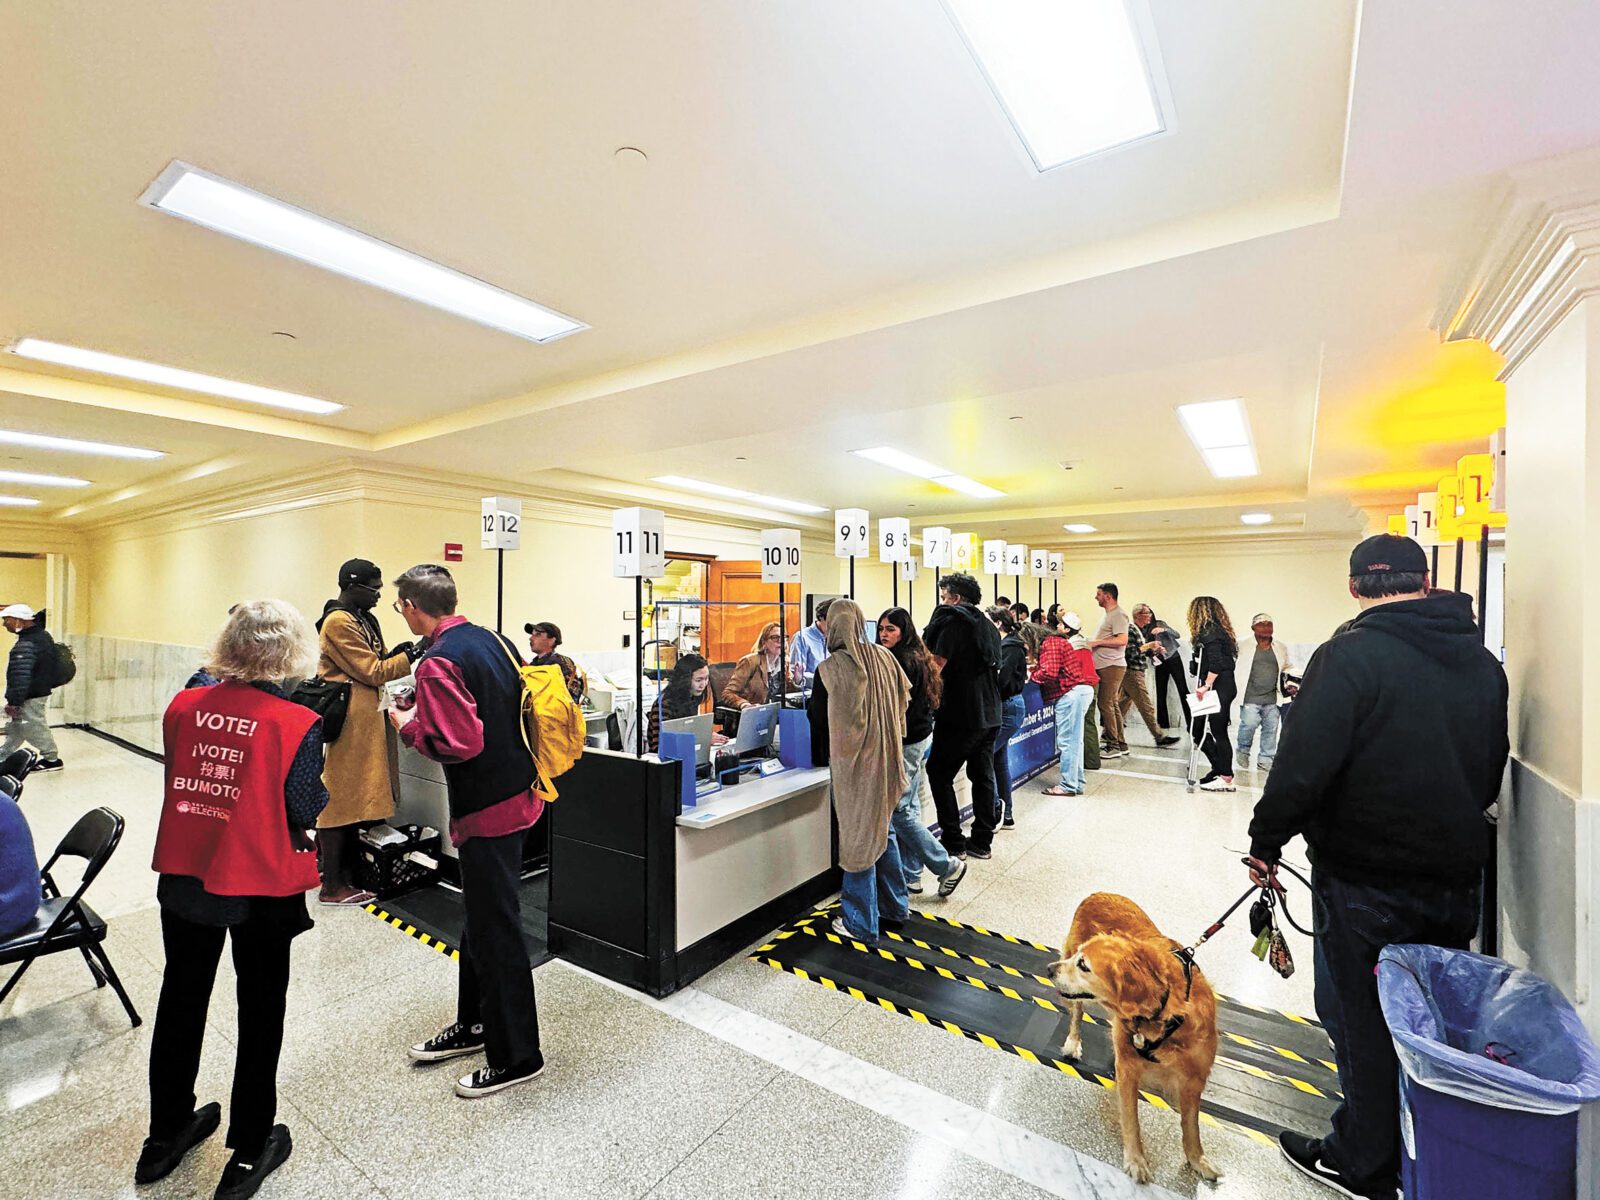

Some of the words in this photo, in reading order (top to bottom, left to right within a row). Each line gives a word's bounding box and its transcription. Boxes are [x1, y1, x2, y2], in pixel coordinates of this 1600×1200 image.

[483, 514, 494, 532] 12
[499, 515, 517, 533] 12
[840, 525, 851, 541] 9
[860, 525, 866, 541] 9
[885, 532, 894, 547] 8
[902, 532, 908, 547] 8
[616, 531, 632, 554] 11
[643, 531, 659, 555] 11
[929, 540, 937, 554] 7
[764, 547, 782, 566] 10
[786, 547, 799, 566] 10
[957, 545, 966, 558] 6
[989, 551, 996, 563] 5
[904, 561, 909, 571] 1
[1011, 555, 1019, 565] 4
[1035, 558, 1043, 569] 3
[1050, 561, 1058, 571] 2
[195, 711, 257, 736] VOTE!
[192, 743, 244, 763] ¡VOTE!
[173, 777, 241, 801] BUMOTO
